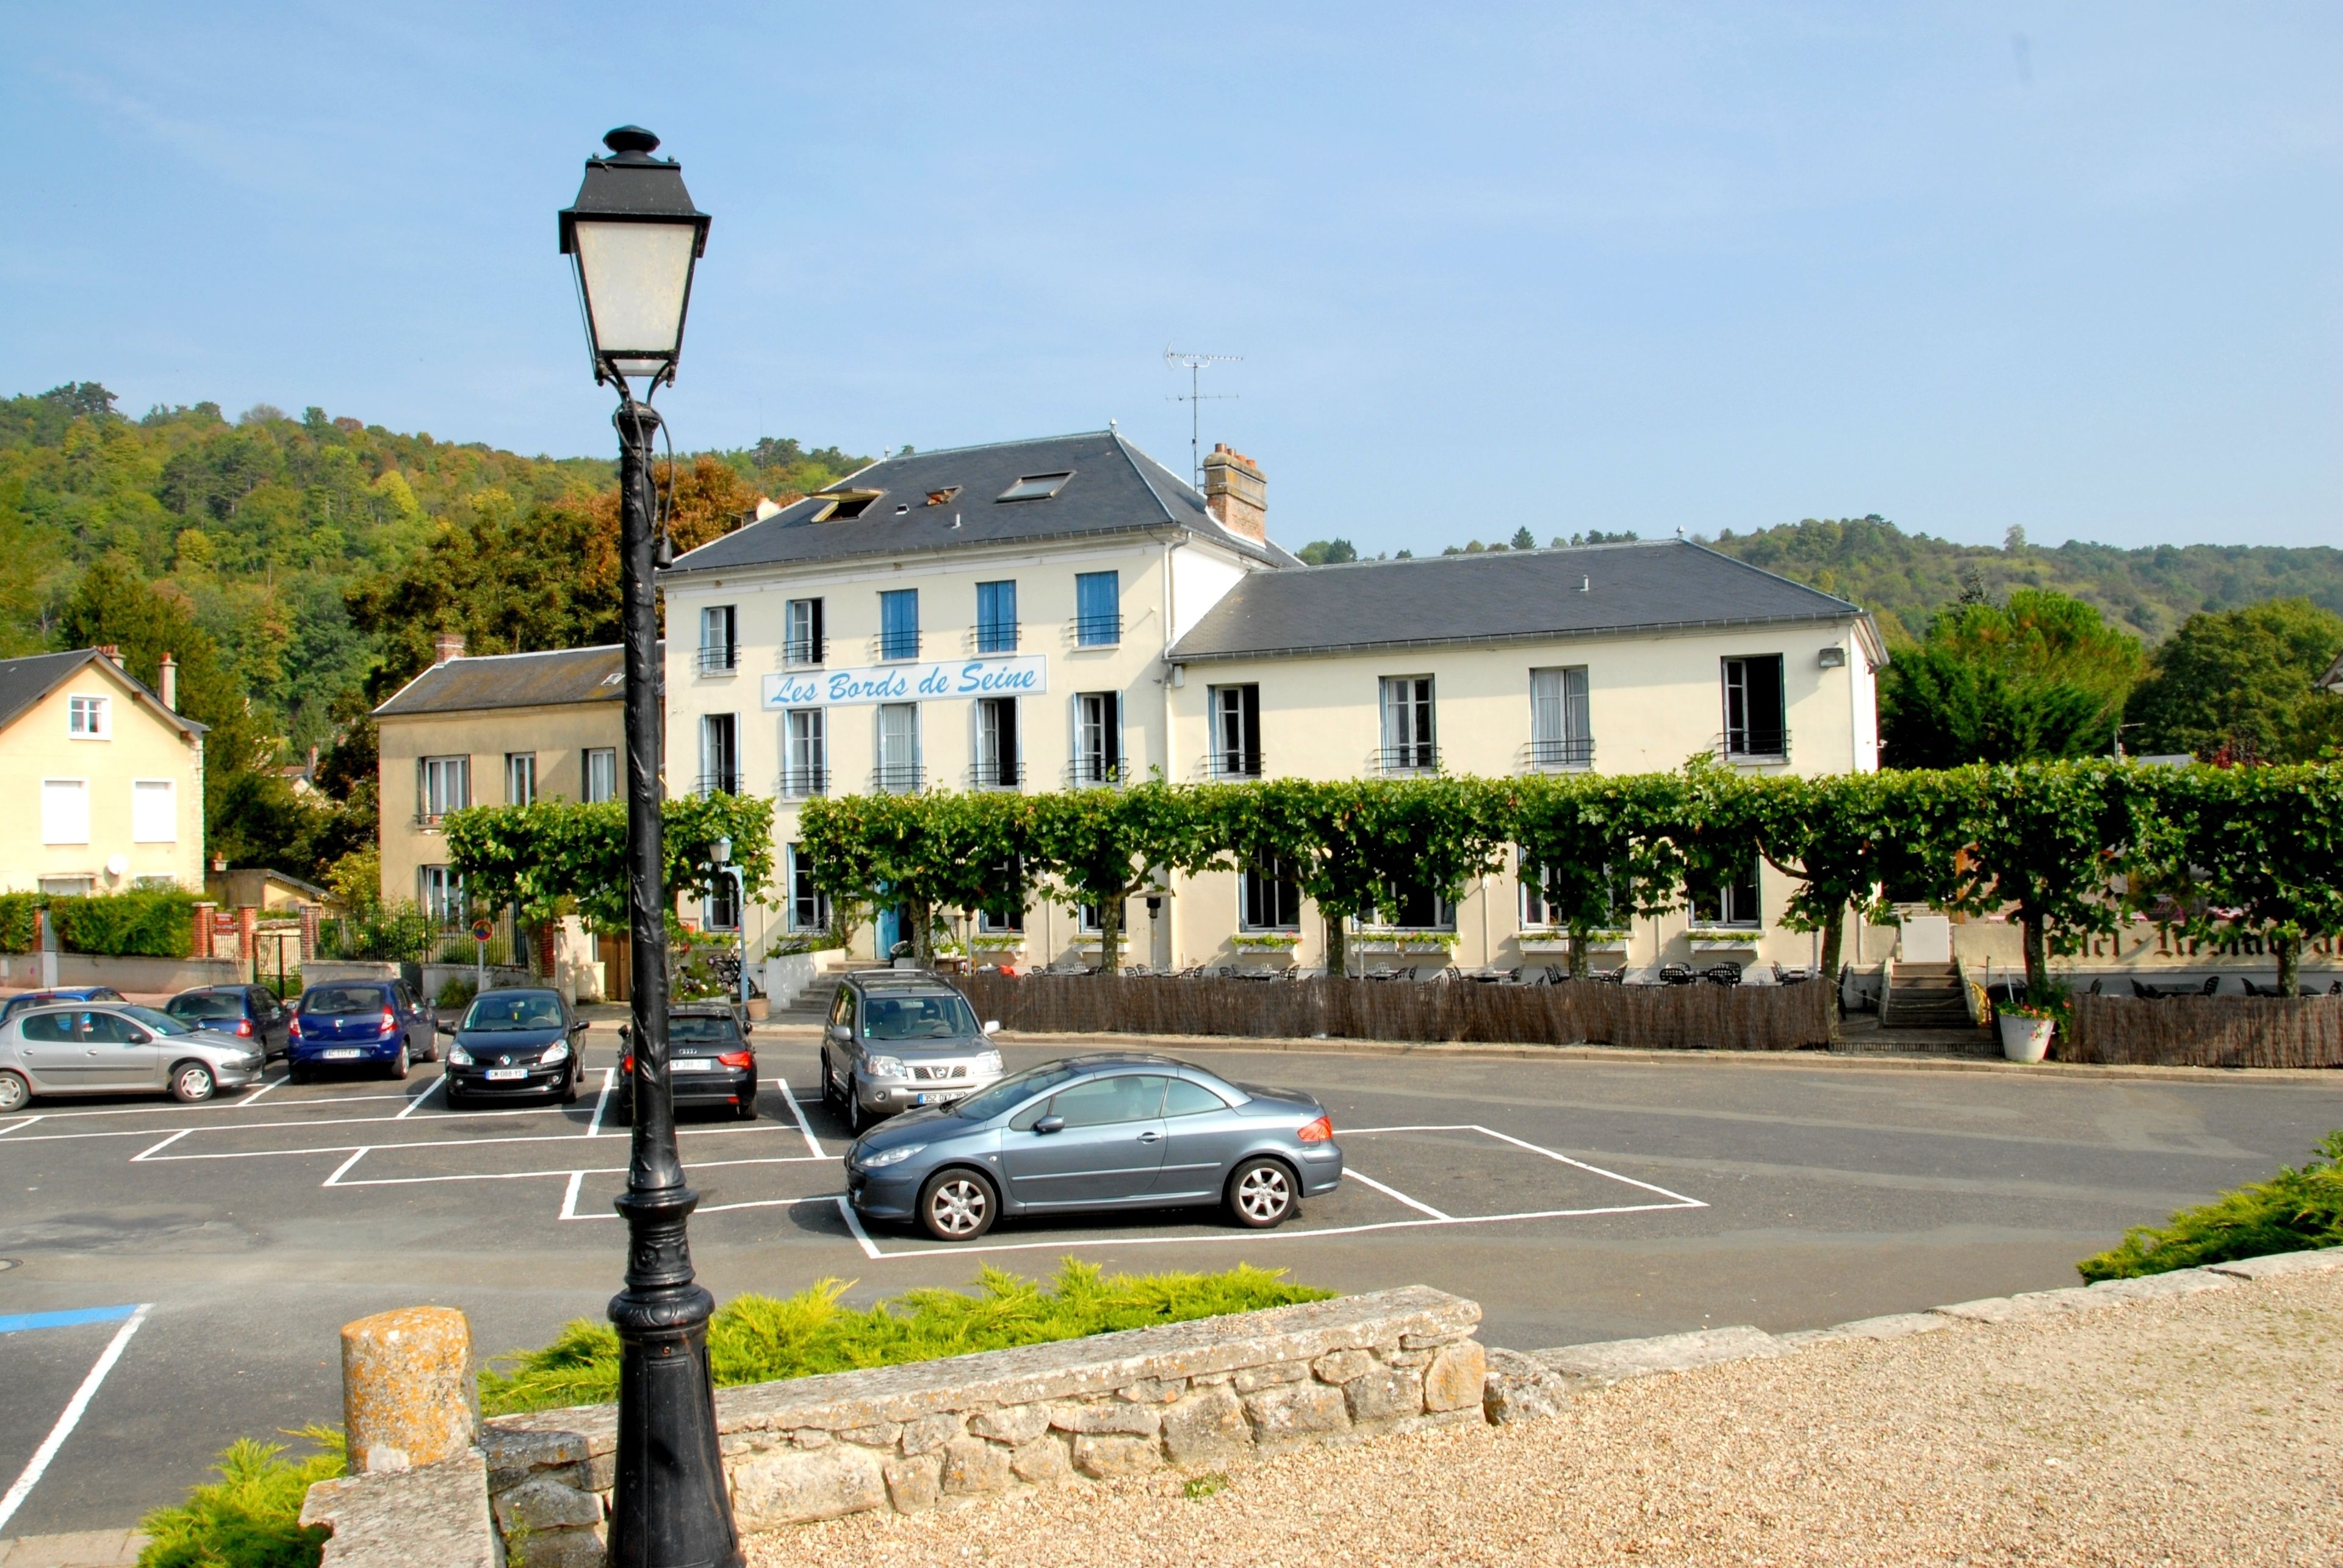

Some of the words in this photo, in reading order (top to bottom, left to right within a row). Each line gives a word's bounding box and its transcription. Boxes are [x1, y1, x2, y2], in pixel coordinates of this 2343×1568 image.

[771, 677, 818, 703] Les
[829, 671, 909, 700] Bords
[918, 666, 949, 694] de
[957, 662, 1037, 693] Seine
[924, 1093, 937, 1102] 352
